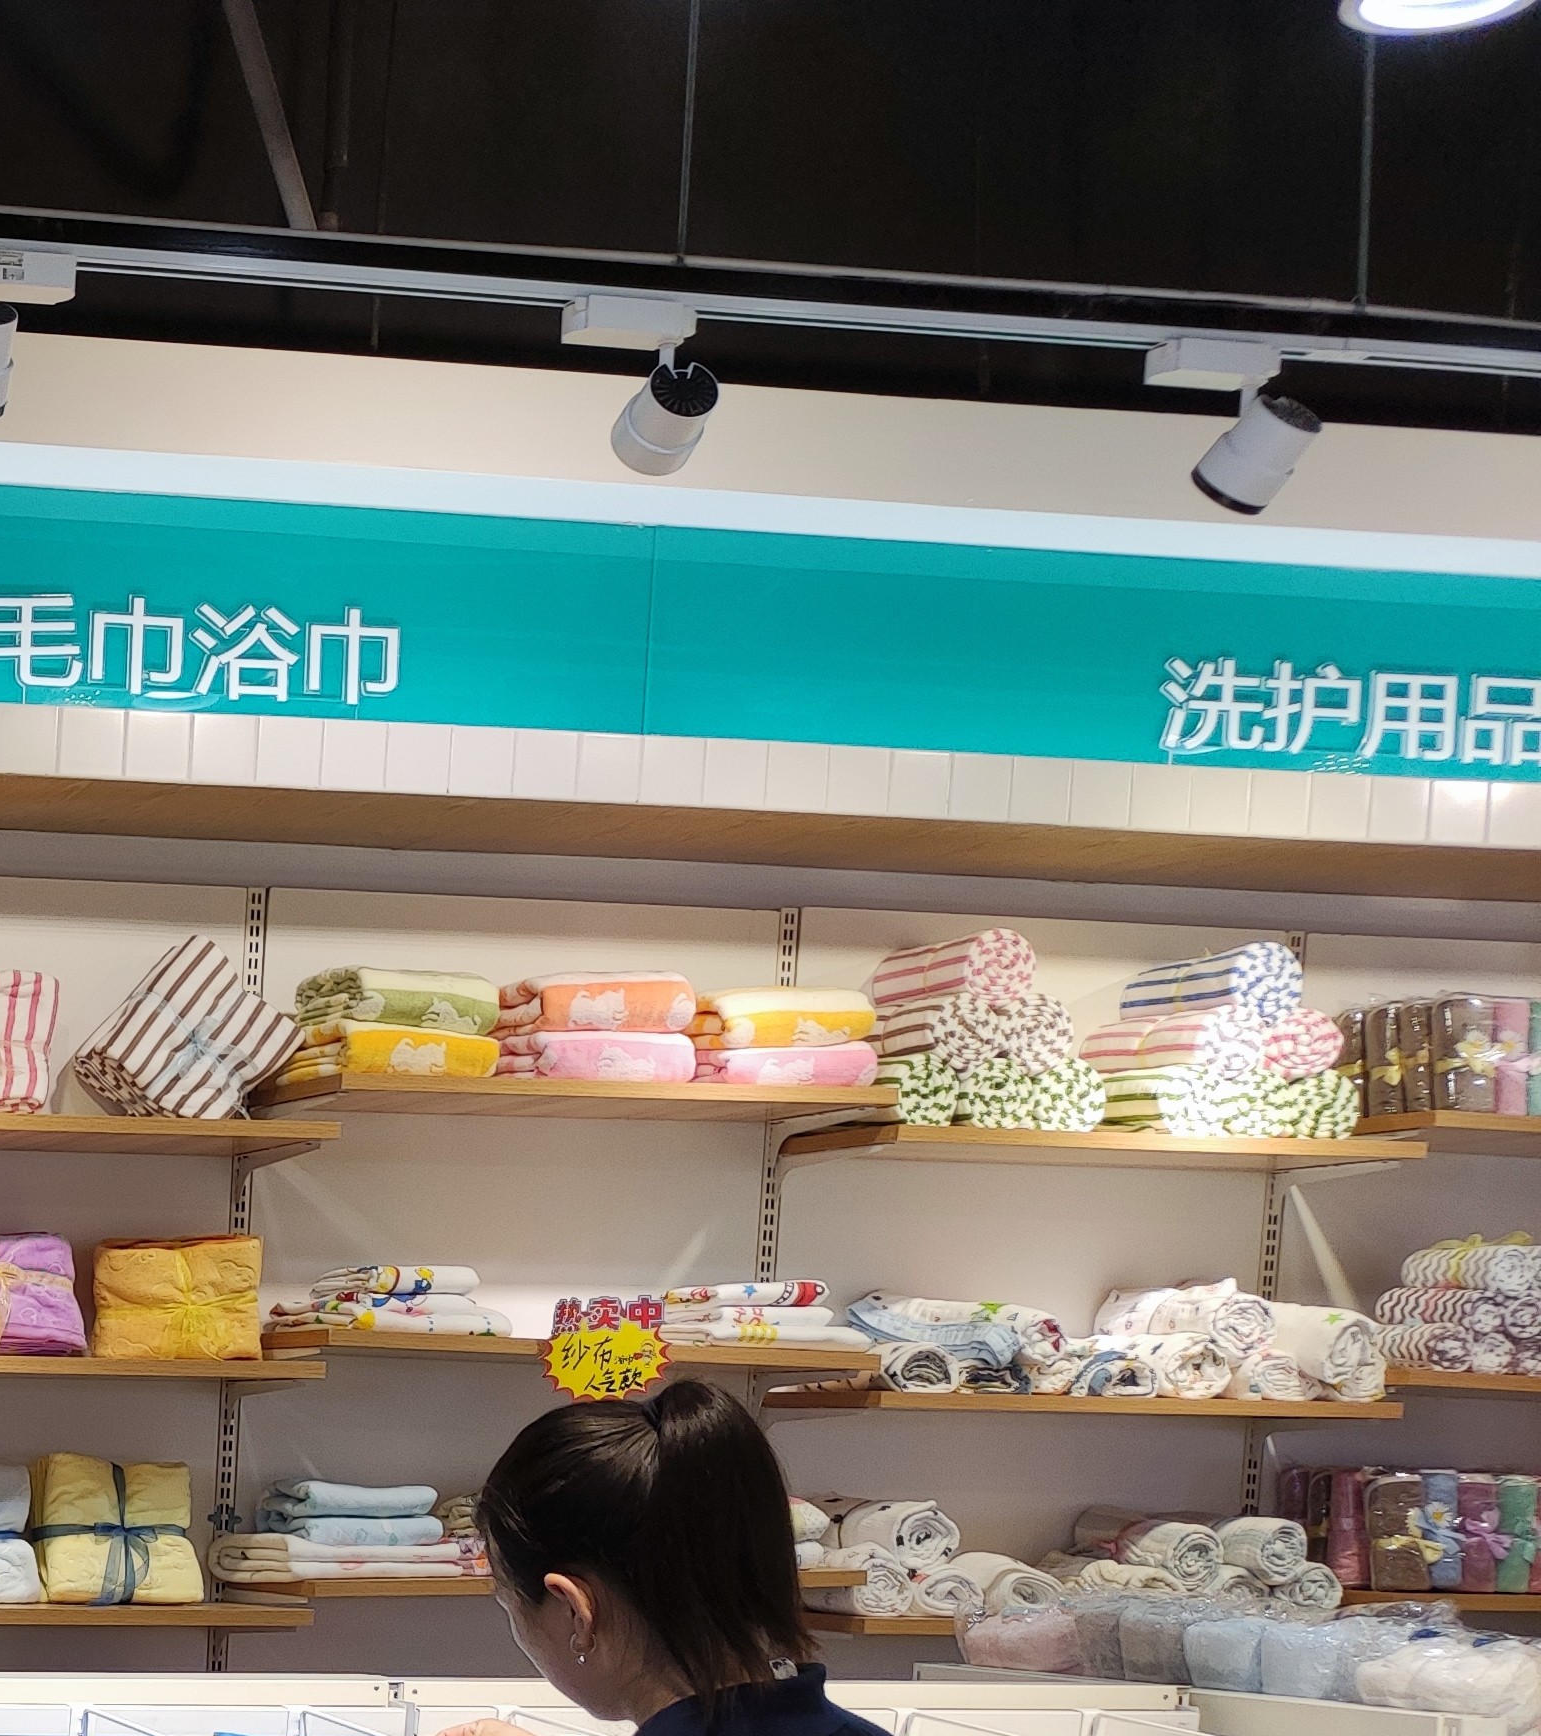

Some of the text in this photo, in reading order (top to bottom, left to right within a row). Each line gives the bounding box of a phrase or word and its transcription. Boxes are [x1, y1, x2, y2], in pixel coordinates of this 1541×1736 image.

[1160, 657, 1541, 765] 洗护用品
[552, 1295, 664, 1335] 热卖中
[561, 1335, 614, 1370] 纱布
[584, 1367, 643, 1392] 人气款
